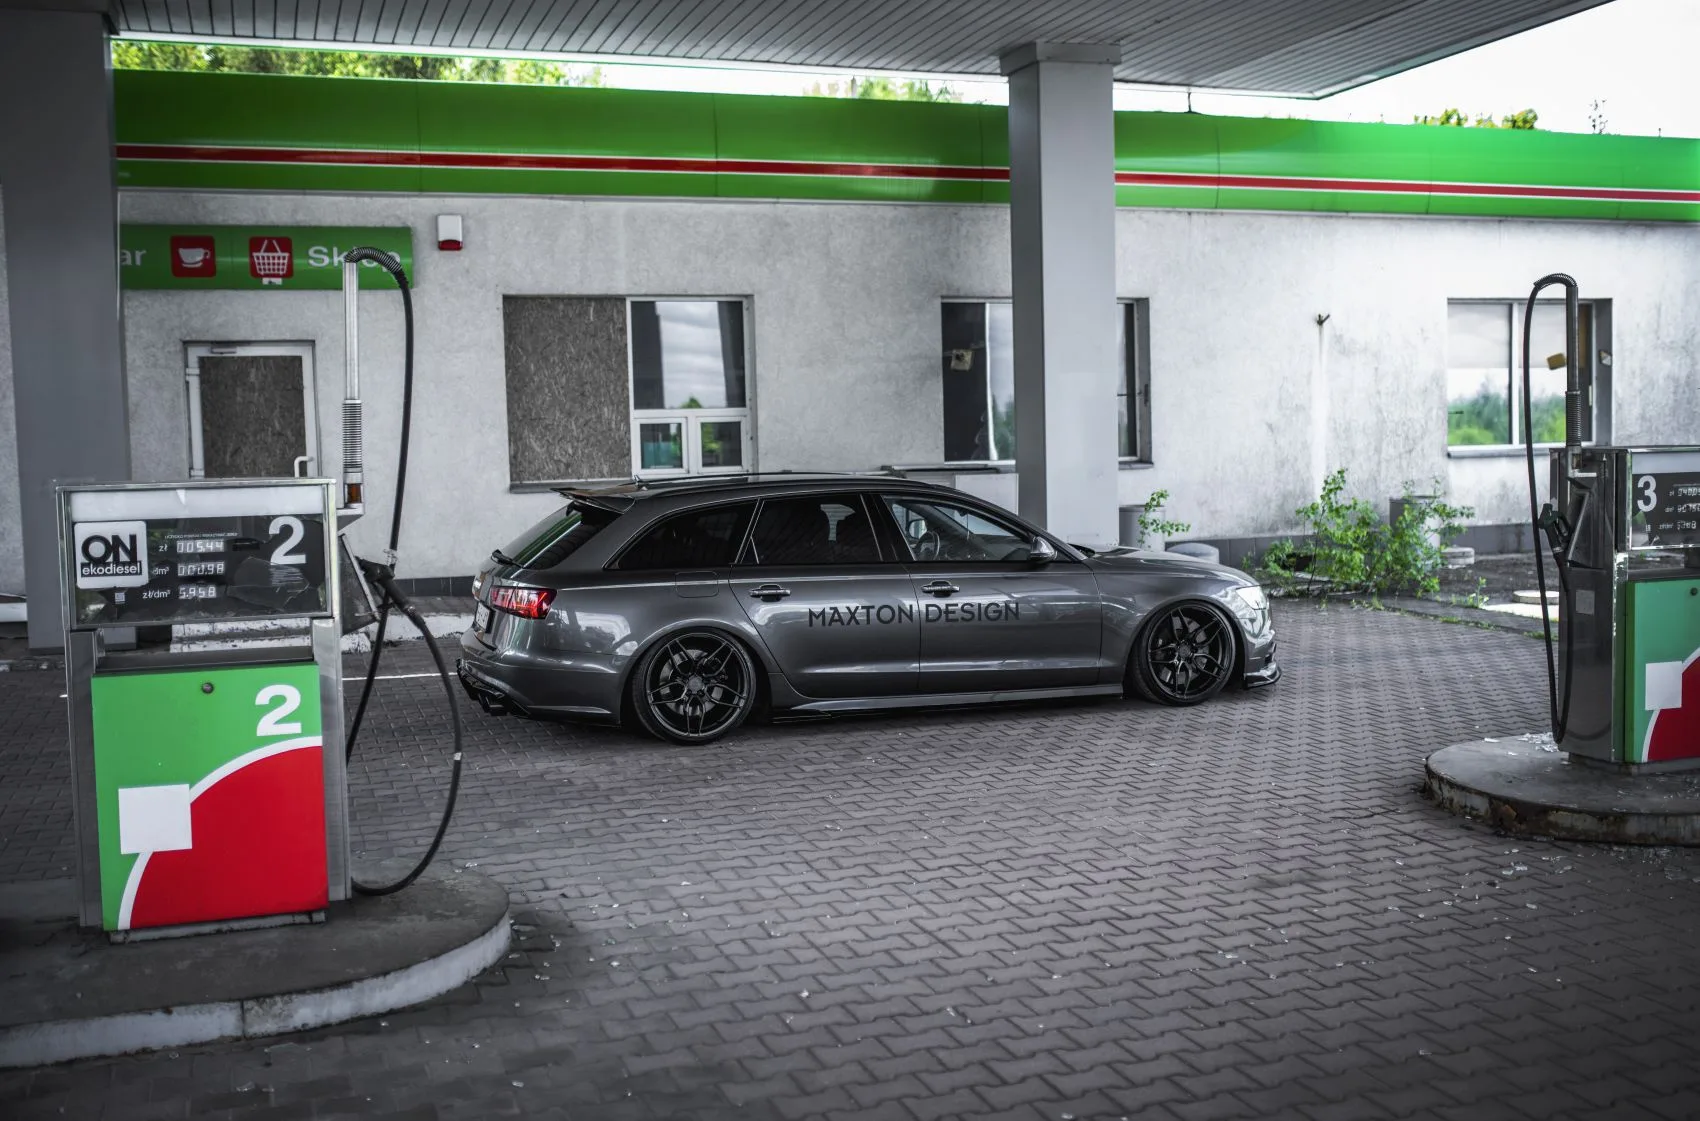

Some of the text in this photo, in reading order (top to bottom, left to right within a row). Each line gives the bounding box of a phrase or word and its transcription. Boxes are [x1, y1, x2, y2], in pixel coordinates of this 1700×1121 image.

[1637, 475, 1657, 512] 3
[81, 534, 137, 562] ON
[268, 516, 307, 565] 2
[82, 562, 141, 575] ekodiesel
[808, 602, 1020, 627] MAXTON DESIGN
[255, 684, 302, 736] 2
